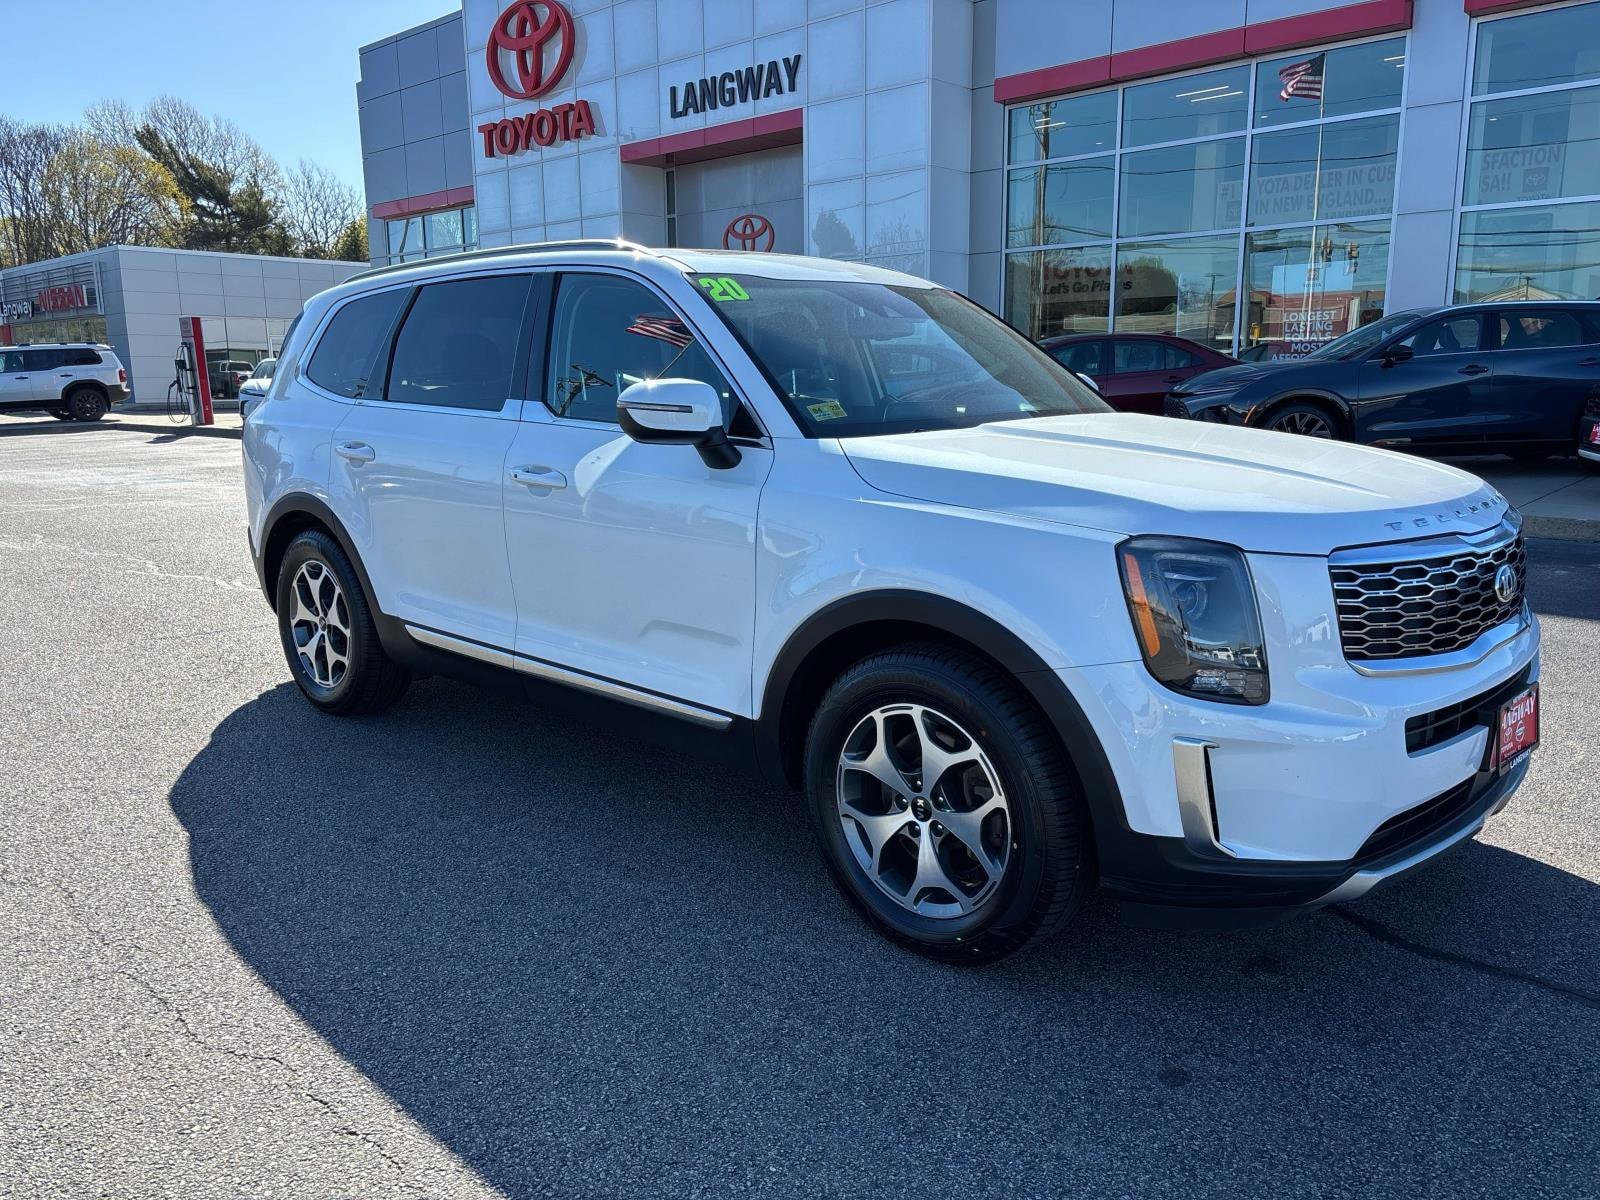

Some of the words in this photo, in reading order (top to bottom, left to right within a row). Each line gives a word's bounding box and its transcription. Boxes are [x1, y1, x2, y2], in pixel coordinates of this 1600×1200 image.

[670, 54, 801, 118] LANGWAY
[478, 100, 597, 158] TOYOTA
[1257, 175, 1290, 196] YOTA
[1347, 168, 1362, 186] IN
[1255, 198, 1269, 215] IN
[1273, 195, 1303, 214] NEW
[38, 283, 88, 311] NISSAN
[699, 277, 750, 301] 20
[1043, 282, 1070, 295] Let's
[1073, 281, 1089, 293] Go
[1091, 279, 1133, 292] Plas
[1284, 310, 1337, 322] LONGEST
[1285, 322, 1333, 333] LASTING
[1285, 332, 1332, 342] EQUALS
[1291, 342, 1324, 353] MOST
